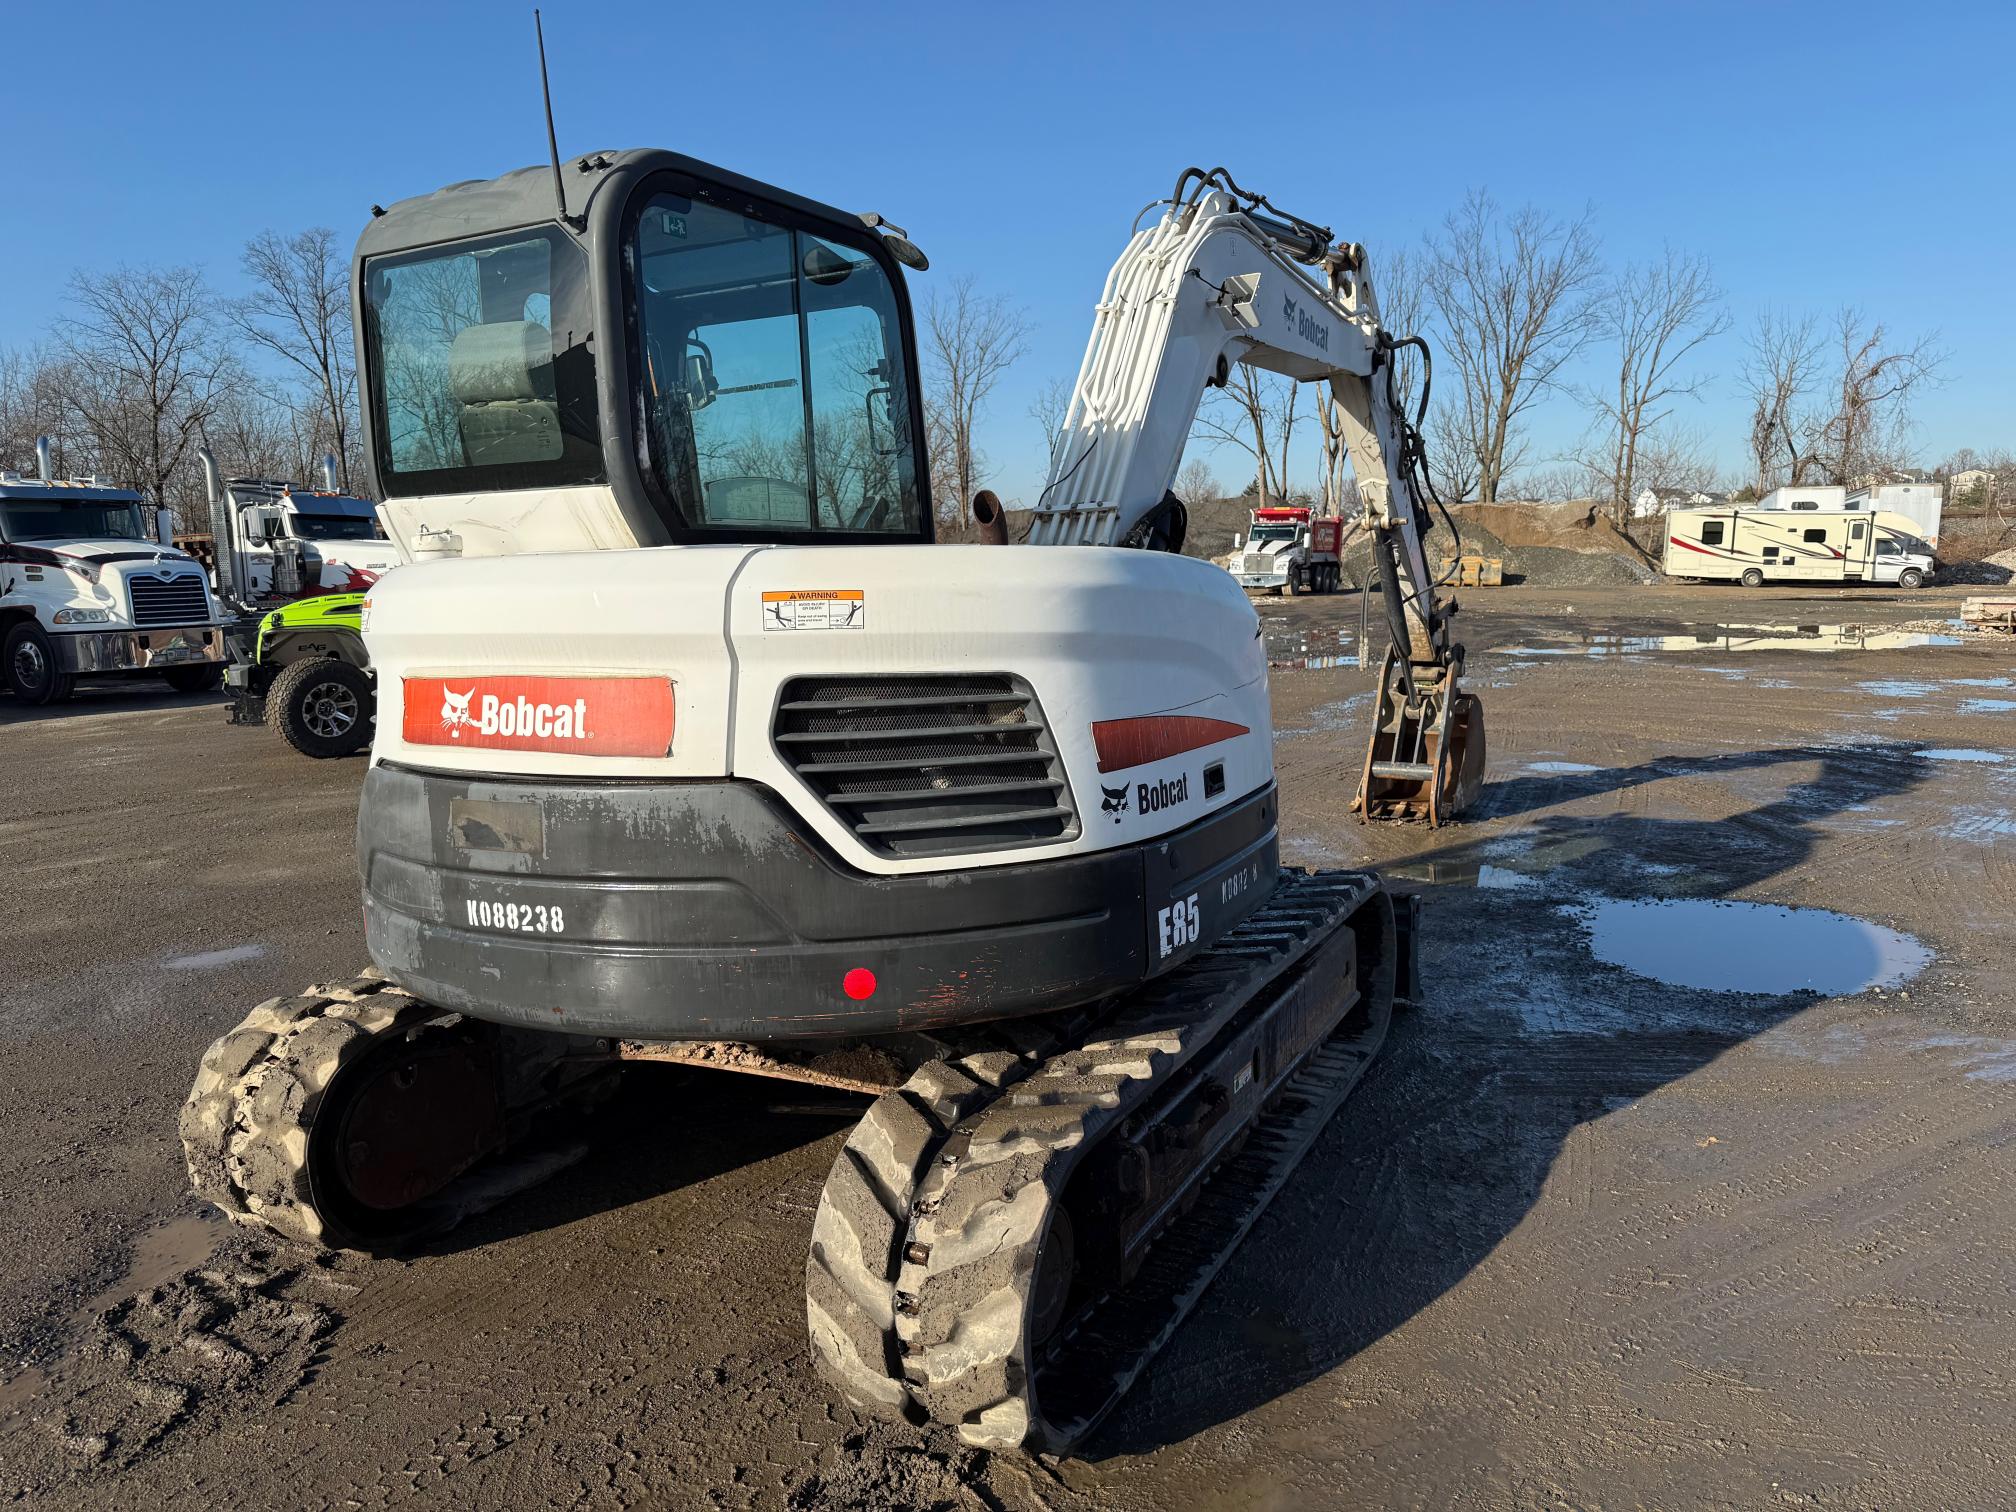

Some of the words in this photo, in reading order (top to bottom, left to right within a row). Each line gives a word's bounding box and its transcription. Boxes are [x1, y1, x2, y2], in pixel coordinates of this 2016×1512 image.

[1298, 307, 1329, 352] Bobcat
[480, 694, 587, 739] Bobcat
[1137, 772, 1189, 815] Bobcat
[1157, 892, 1200, 959] E85
